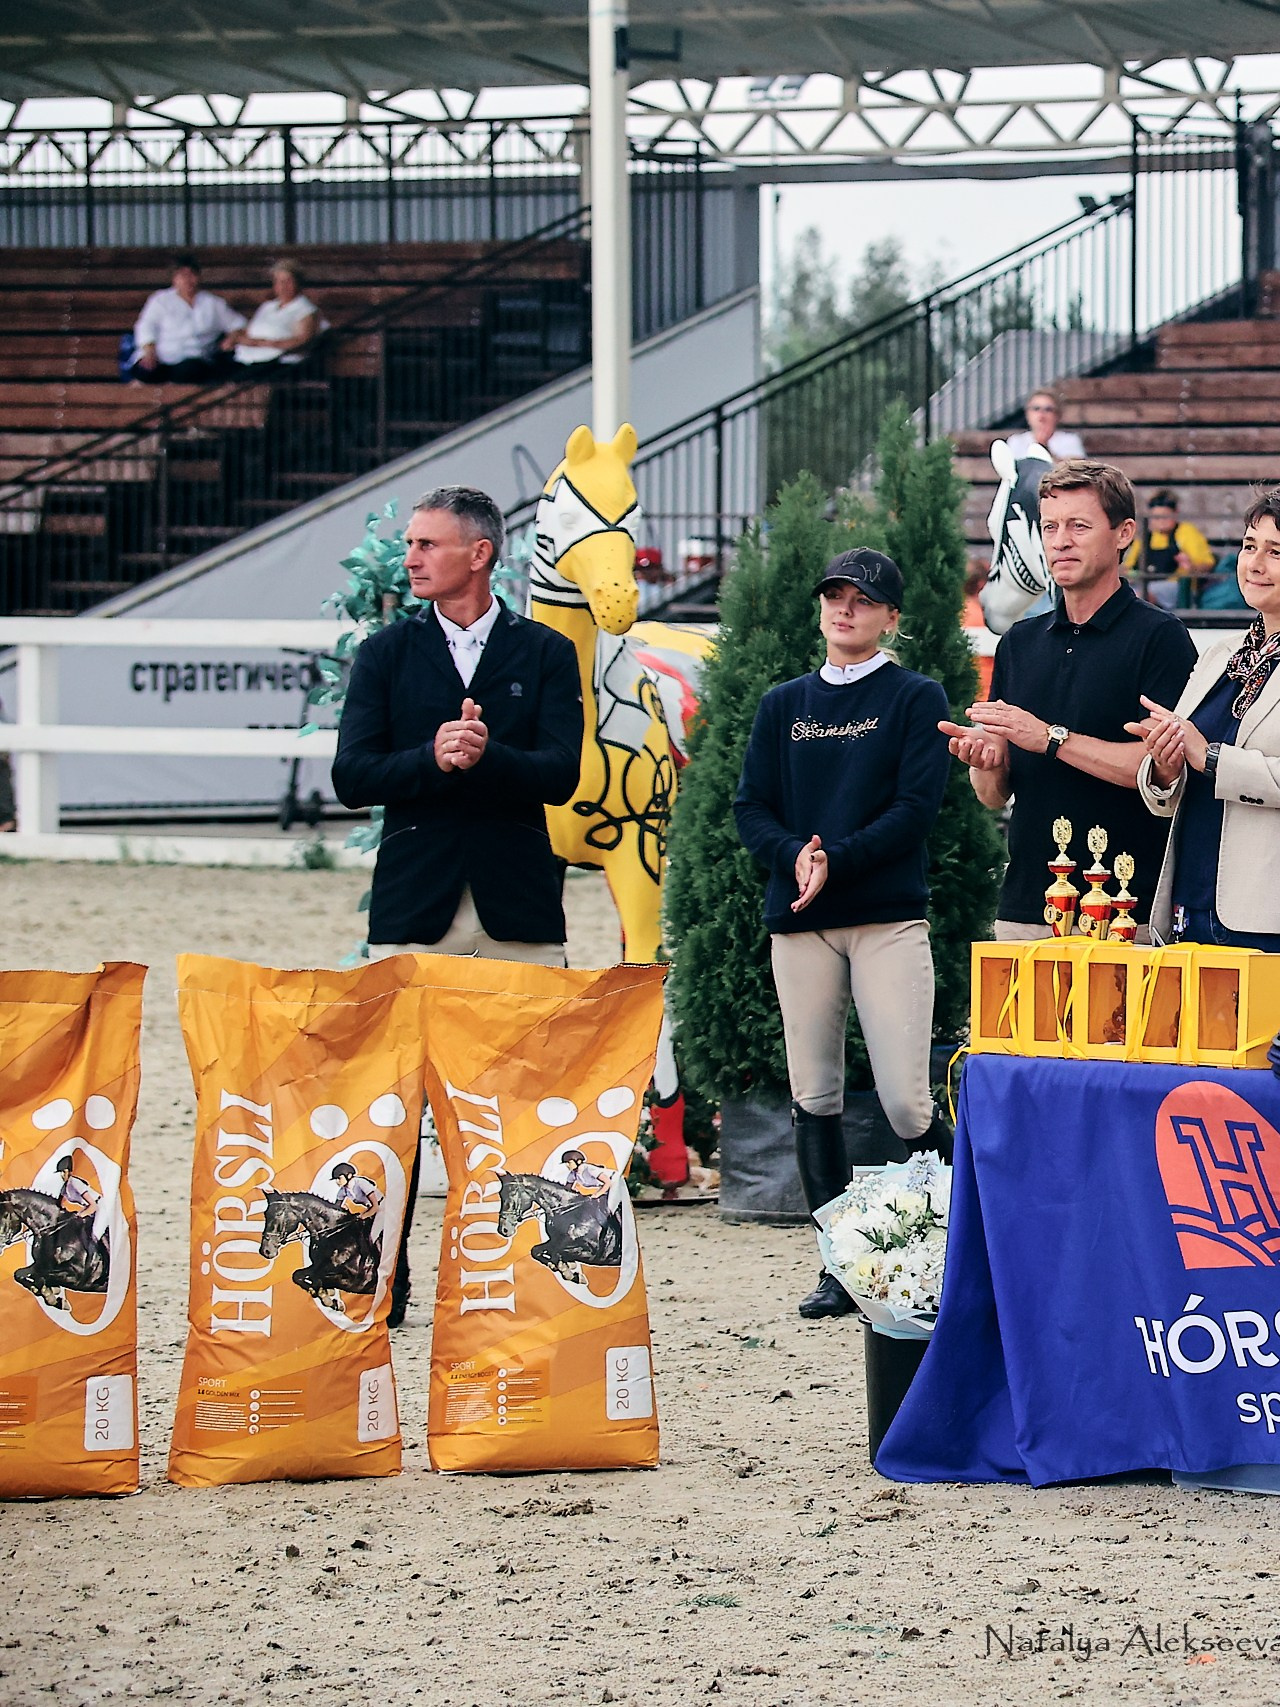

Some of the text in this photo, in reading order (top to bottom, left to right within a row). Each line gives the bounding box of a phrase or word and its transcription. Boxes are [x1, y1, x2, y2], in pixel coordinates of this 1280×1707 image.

[200, 1088, 277, 1338] HÖRSLI
[445, 1080, 517, 1317] HÖRSLI
[198, 1376, 228, 1388] SPORT
[450, 1361, 476, 1372] SPORT
[615, 1357, 630, 1410] 20 KG
[95, 1386, 110, 1441] 20 KG
[367, 1379, 379, 1432] 20 KG
